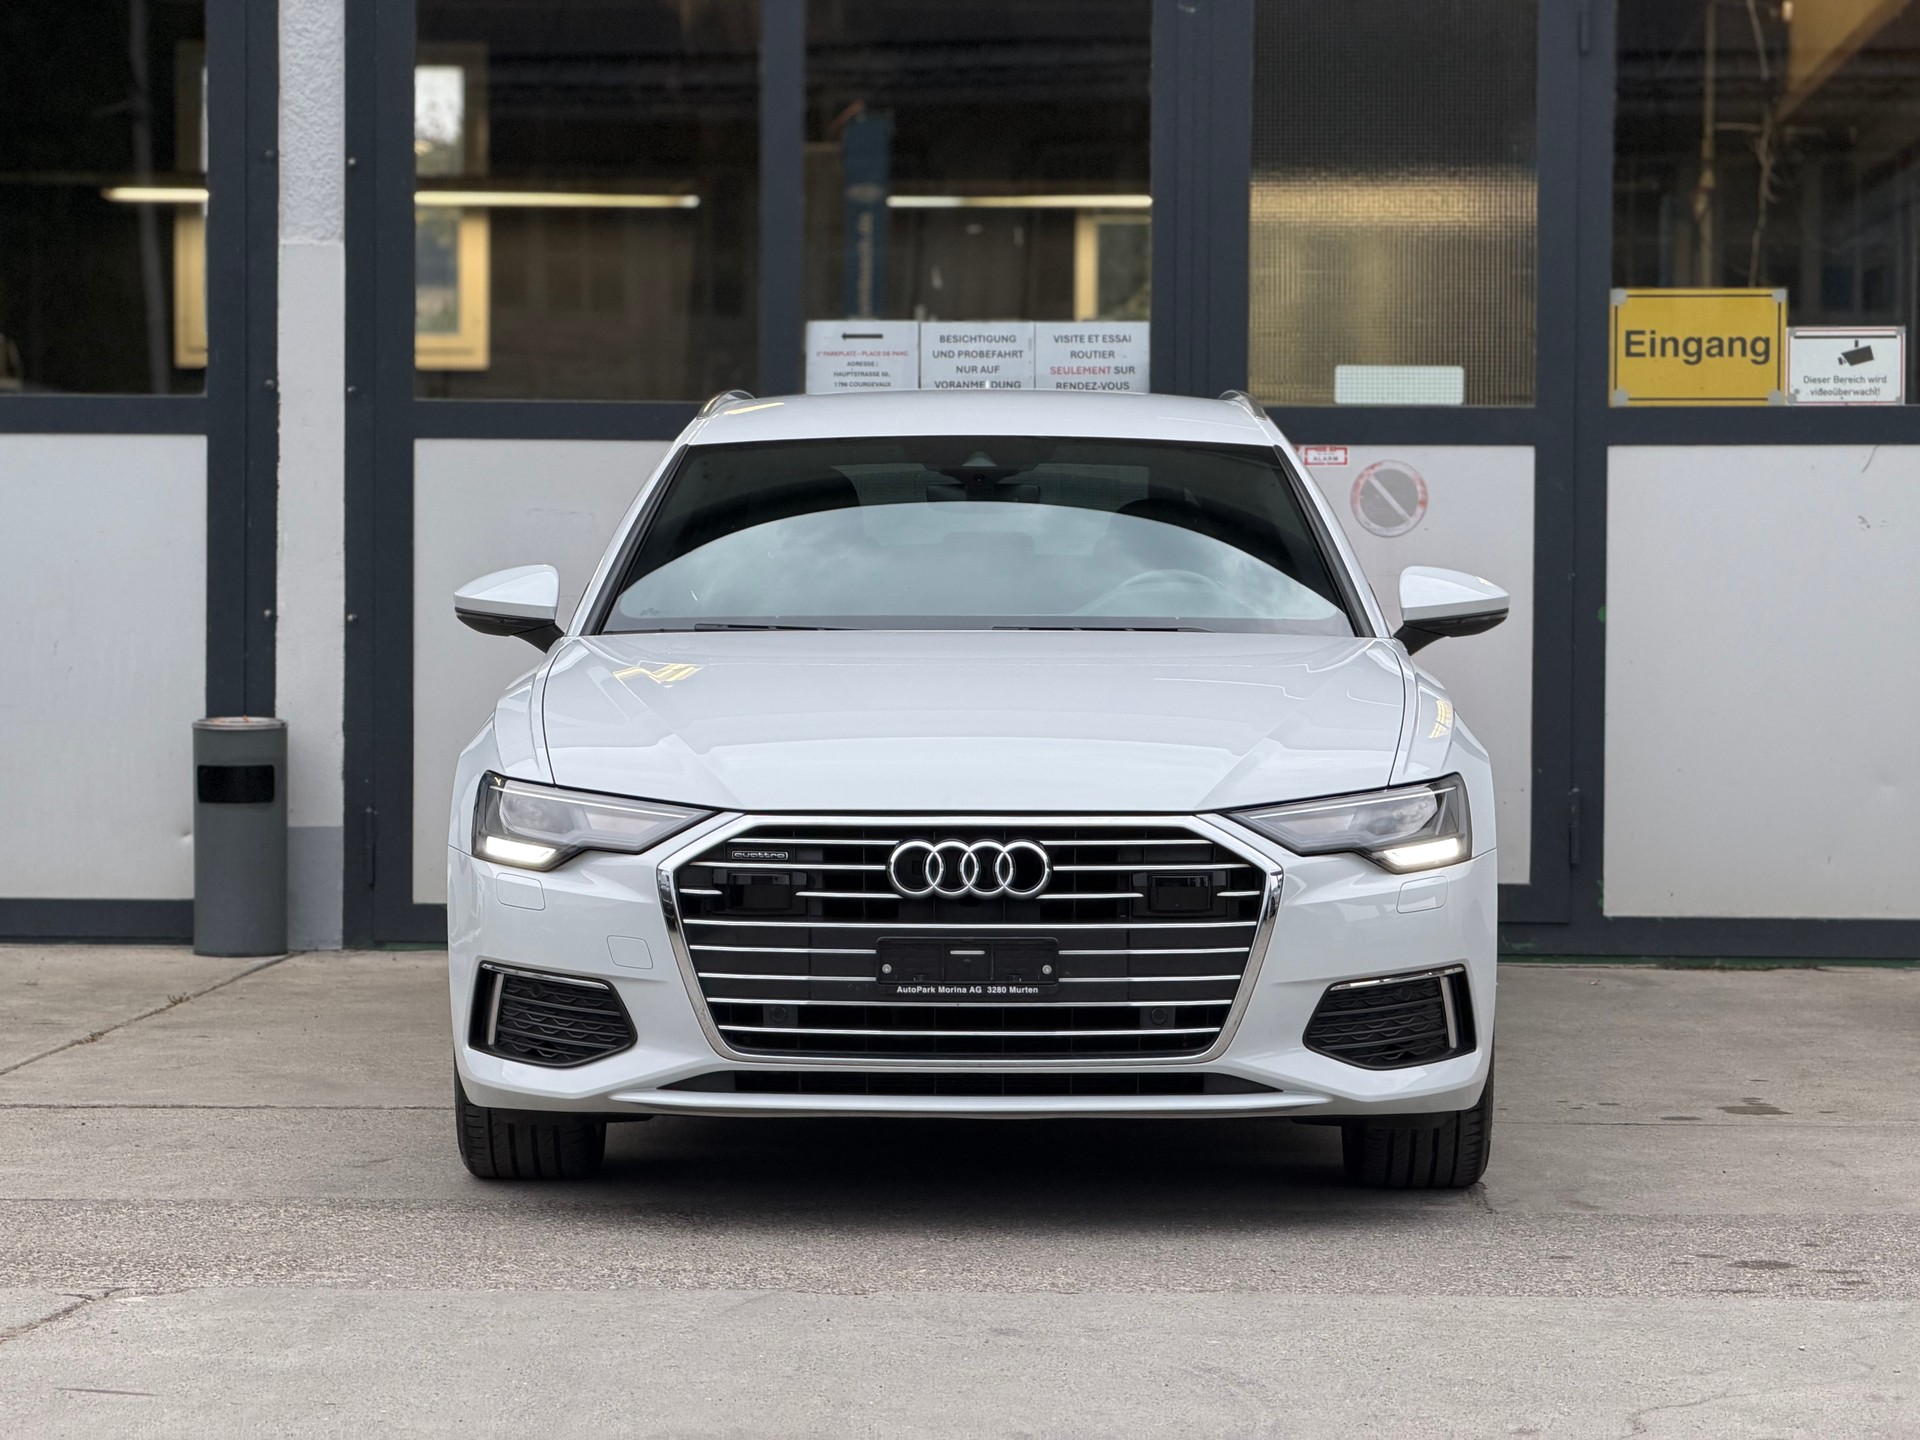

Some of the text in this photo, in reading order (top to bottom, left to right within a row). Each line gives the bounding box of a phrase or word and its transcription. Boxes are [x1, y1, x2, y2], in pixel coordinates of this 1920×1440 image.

[939, 334, 1017, 344] BESICHTIGUNG
[1053, 334, 1132, 344] VISITE ET ESSAI
[1625, 330, 1771, 365] Eingang
[932, 350, 1024, 359] UND PROBEFAHRT
[1070, 350, 1115, 359] ROUTIER
[956, 365, 1000, 374] NUR AUF
[1050, 366, 1136, 375] SEULEMENT SUR
[1803, 375, 1887, 384] Dieser Bereich wird
[934, 380, 1022, 389] VORANMEDUNG
[1056, 381, 1130, 390] RENDEZ-VOUS
[896, 985, 1039, 994] AutoPark Morina AG 3280 Murten
